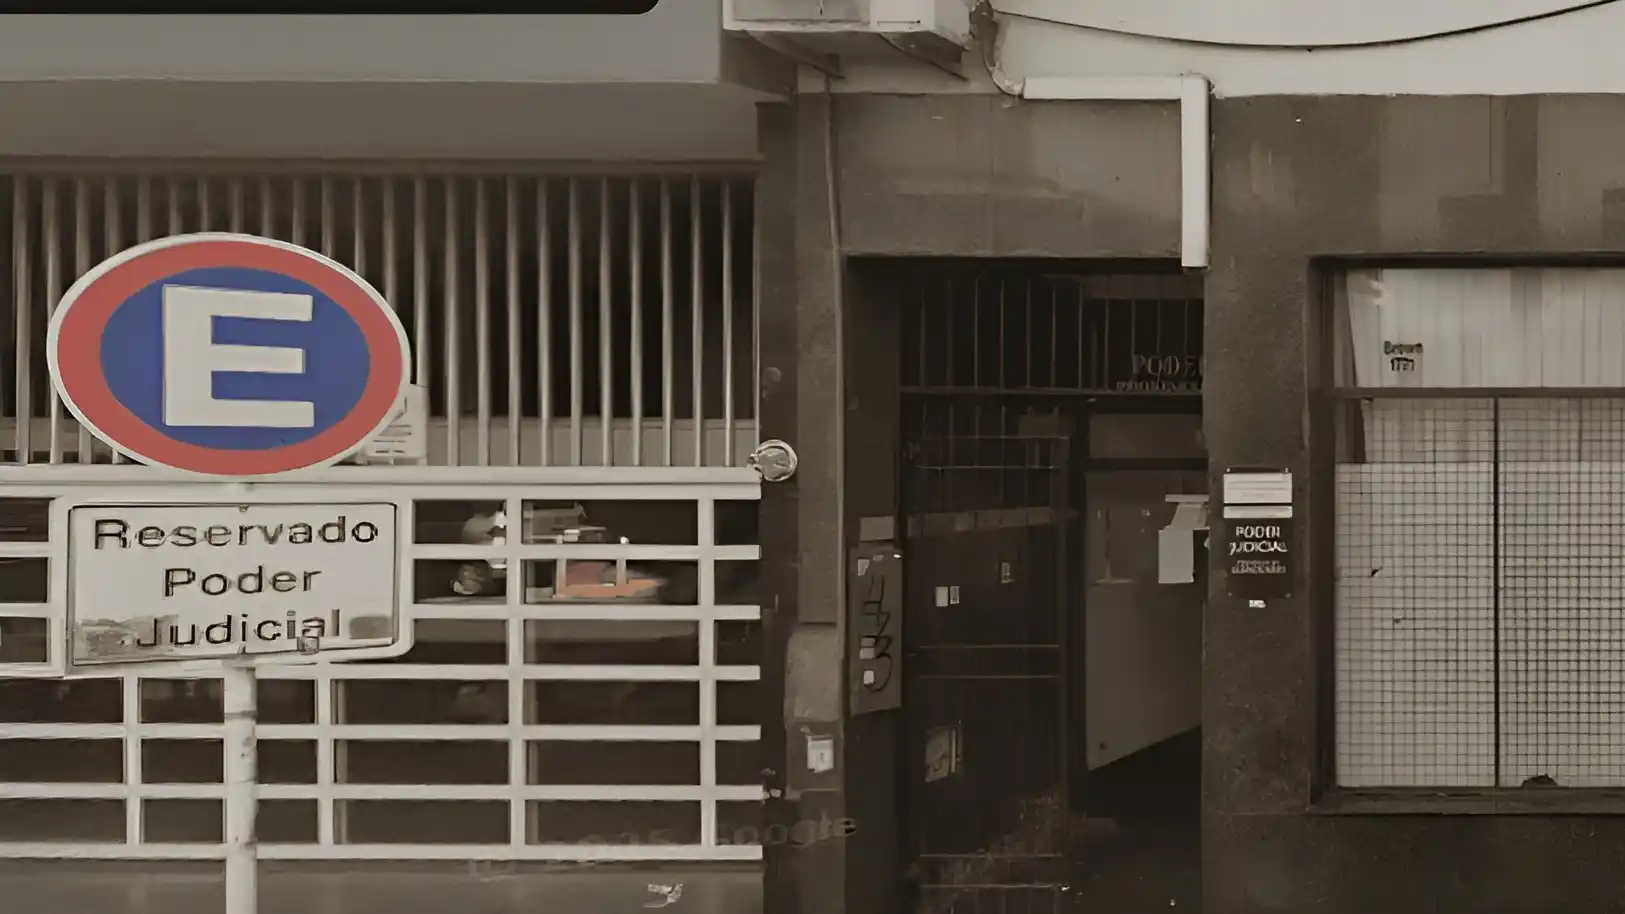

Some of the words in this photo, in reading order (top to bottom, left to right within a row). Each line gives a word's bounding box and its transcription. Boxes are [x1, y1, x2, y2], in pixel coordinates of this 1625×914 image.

[161, 283, 315, 428] E
[94, 515, 379, 550] Reservado
[163, 565, 322, 597] Poder
[136, 608, 341, 647] Judicial
